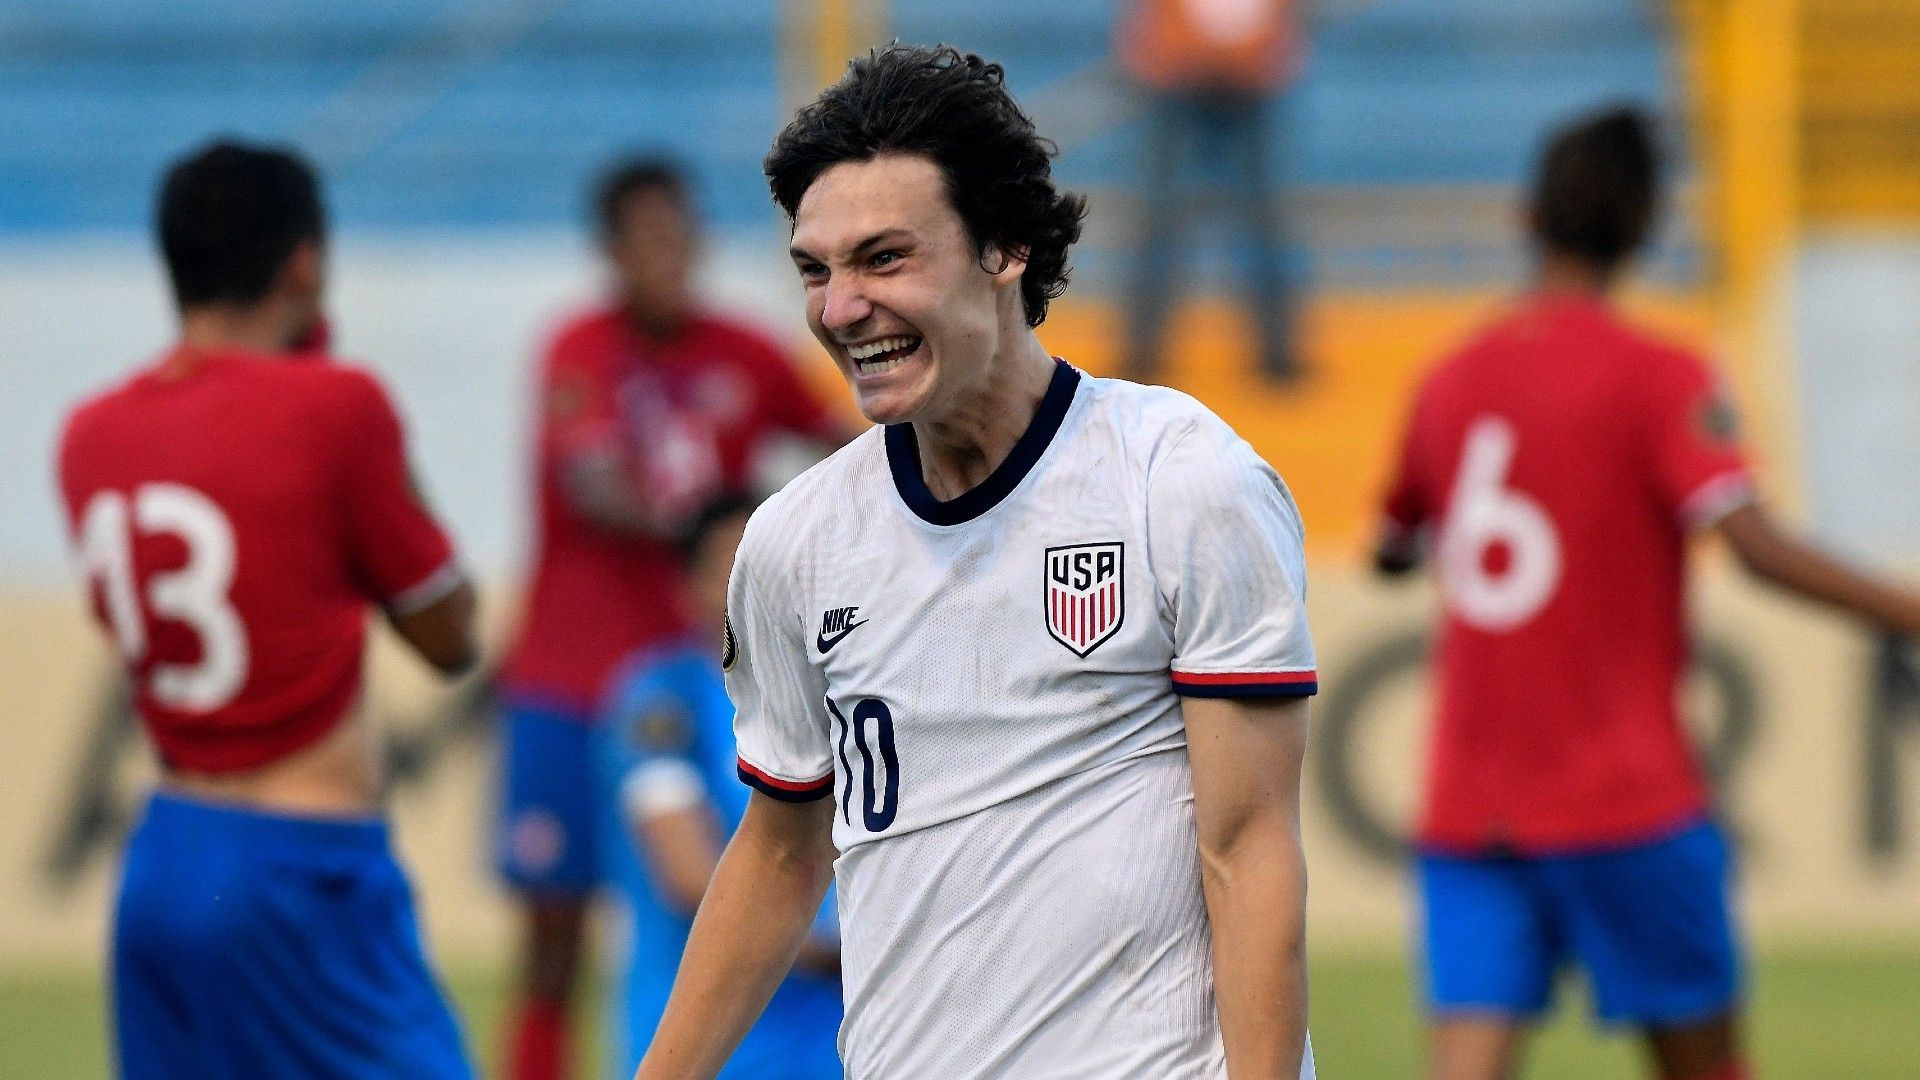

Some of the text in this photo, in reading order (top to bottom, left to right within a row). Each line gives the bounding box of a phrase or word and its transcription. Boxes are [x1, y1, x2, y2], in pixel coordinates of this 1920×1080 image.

[1052, 551, 1115, 591] USA
[1439, 415, 1561, 632] 6
[80, 482, 250, 714] 13
[822, 606, 860, 634] NIKE
[826, 695, 900, 833] 10
